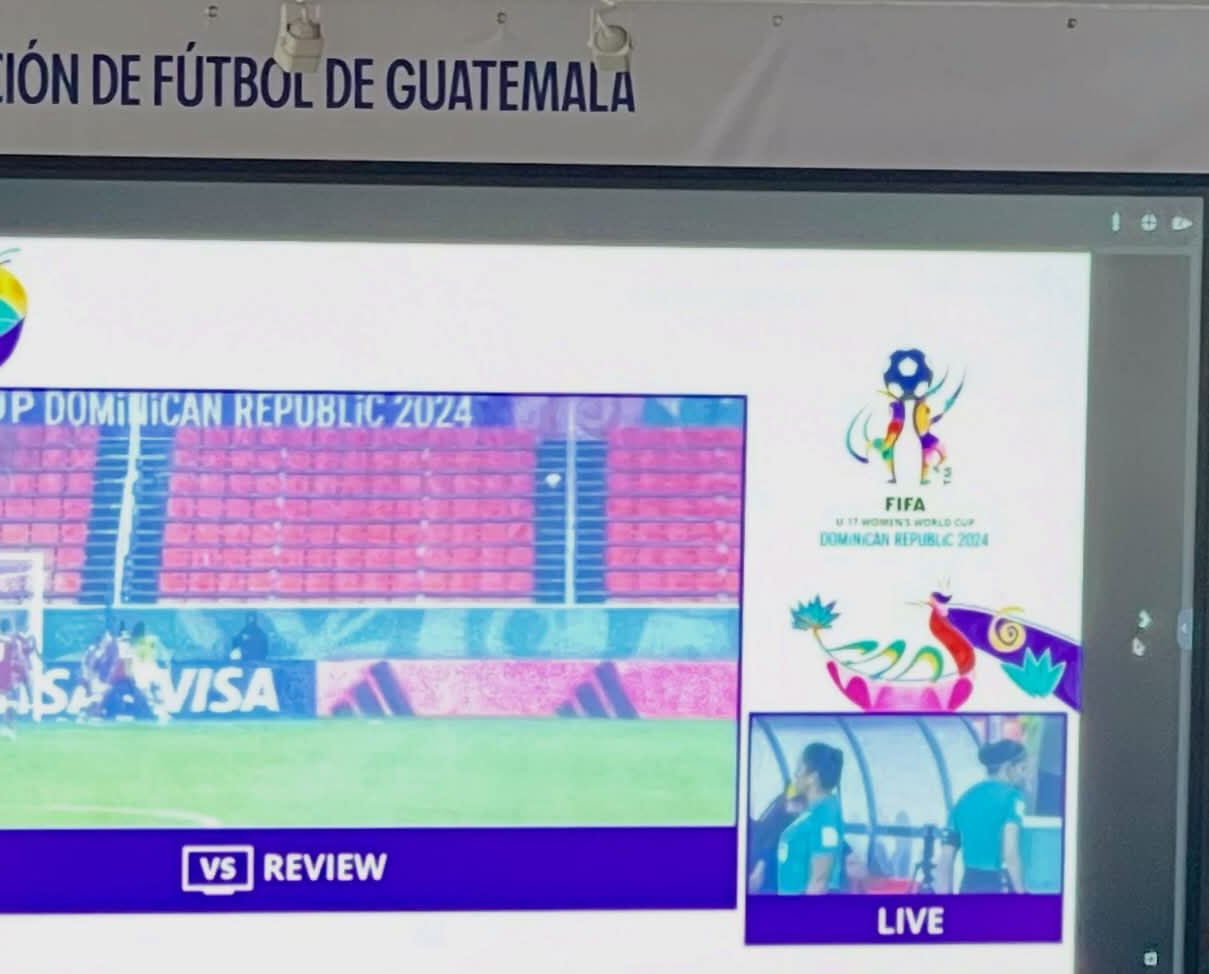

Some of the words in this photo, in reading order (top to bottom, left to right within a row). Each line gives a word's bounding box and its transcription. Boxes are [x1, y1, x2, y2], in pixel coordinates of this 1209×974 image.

[92, 54, 141, 106] DE
[154, 42, 313, 109] FÚTBOL
[326, 58, 374, 110] DE
[386, 59, 635, 113] GUATEMALA
[392, 396, 473, 428] 2024
[885, 496, 926, 511] FIFA
[914, 518, 952, 527] WORLD
[954, 518, 975, 527] CUP
[957, 532, 989, 546] 2024
[162, 667, 281, 714] VISA
[198, 857, 238, 881] VS
[263, 853, 388, 882] REVIEW
[876, 906, 945, 936] LIVE
